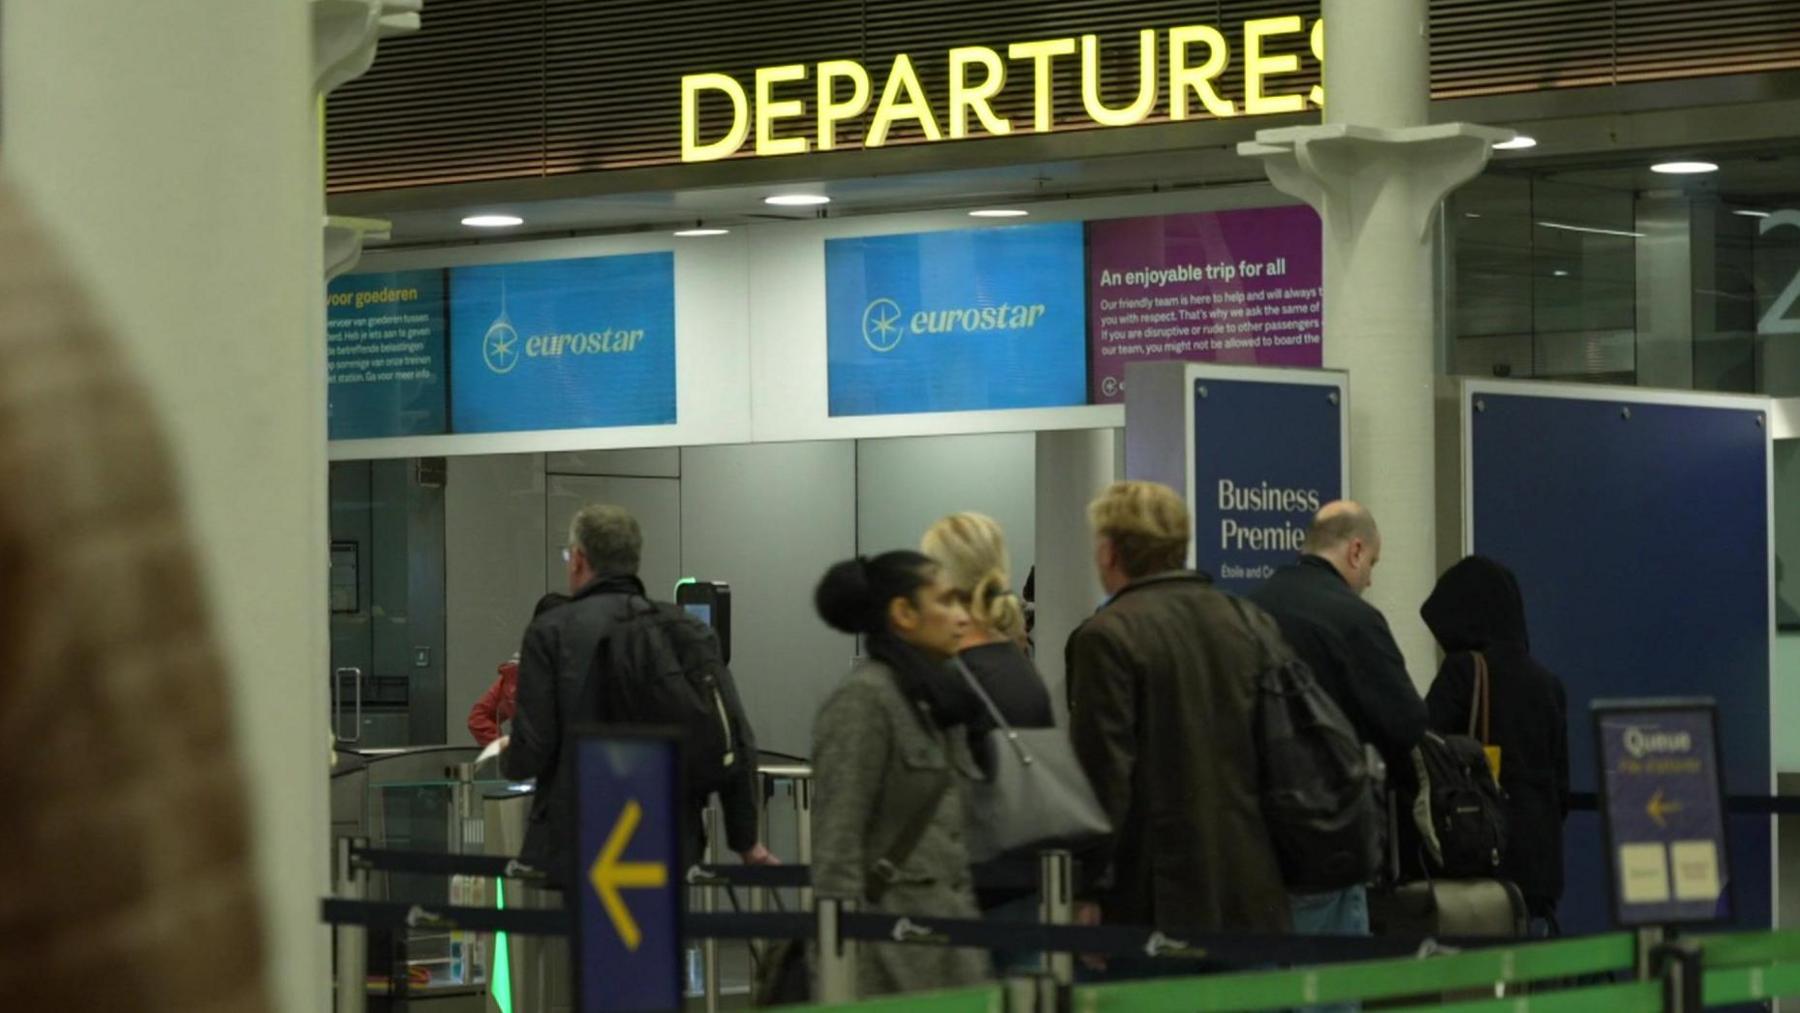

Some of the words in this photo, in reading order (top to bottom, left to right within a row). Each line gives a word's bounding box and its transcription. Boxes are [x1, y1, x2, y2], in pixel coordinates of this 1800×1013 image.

[681, 15, 1323, 162] DEPARTURE
[1100, 268, 1121, 287] An
[1125, 264, 1203, 289] enjoyable
[1205, 261, 1236, 283] trip
[1238, 260, 1263, 277] for
[1266, 257, 1286, 276] all
[356, 287, 417, 308] goederen
[1101, 299, 1117, 310] Our
[1118, 297, 1153, 310] friendly
[1155, 297, 1178, 307] team
[1180, 294, 1188, 306] is
[1190, 294, 1211, 305] here
[1213, 293, 1223, 303] to
[1224, 291, 1245, 304] help
[1247, 290, 1265, 301] and
[1266, 288, 1282, 300] will
[1284, 288, 1316, 300] always
[910, 302, 1045, 335] eurostar
[1101, 316, 1118, 327] you
[1119, 312, 1138, 324] with
[1140, 311, 1177, 324] respect.
[1179, 308, 1207, 321] That's
[1209, 308, 1229, 320] why
[1230, 307, 1243, 318] we
[1245, 305, 1262, 316] ask
[1264, 304, 1280, 315] the
[1282, 304, 1308, 315] same
[1310, 301, 1320, 313] of
[525, 325, 645, 358] eurostar
[1101, 330, 1108, 340] If
[1109, 330, 1126, 342] you
[1127, 329, 1142, 340] are
[1144, 325, 1189, 339] disruptive
[1191, 325, 1202, 336] or
[1203, 322, 1225, 335] rude
[1226, 322, 1236, 333] to
[1238, 320, 1263, 333] other
[1264, 319, 1319, 334] passengers
[1102, 346, 1117, 356] our
[1145, 343, 1163, 355] you
[1164, 340, 1191, 355] might
[1193, 339, 1209, 351] not
[1210, 338, 1223, 350] be
[1224, 336, 1261, 349] allowed
[1262, 336, 1273, 347] to
[1274, 333, 1303, 346] board
[1304, 333, 1321, 344] the
[1218, 479, 1320, 512] Business
[1221, 518, 1306, 551] Premie
[1246, 565, 1261, 579] and
[1622, 726, 1691, 758] Queue
